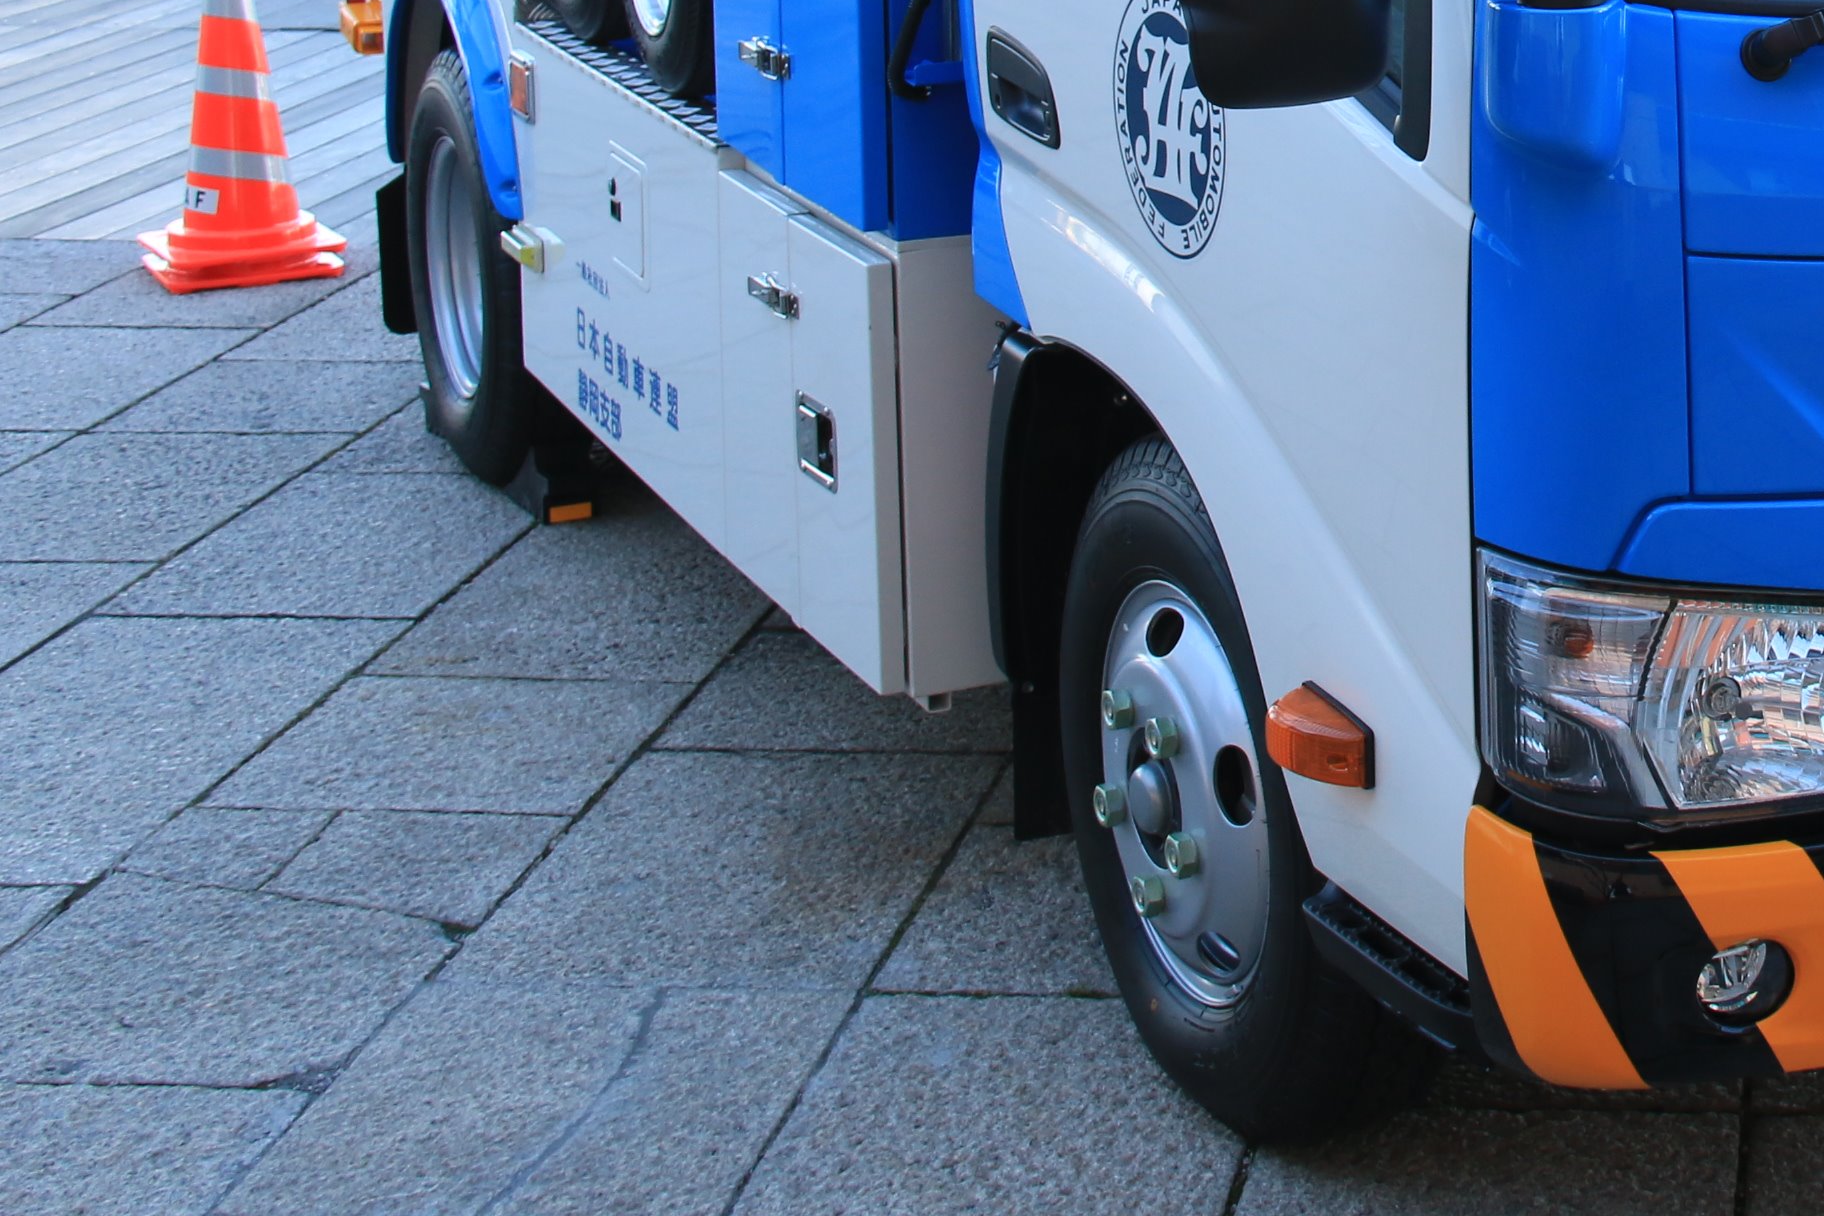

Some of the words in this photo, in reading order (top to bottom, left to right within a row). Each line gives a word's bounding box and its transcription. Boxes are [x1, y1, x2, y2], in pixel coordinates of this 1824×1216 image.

[1116, 40, 1166, 239] FEDERATION
[577, 306, 680, 432] 日本自動車連盟
[578, 367, 623, 442] 静岡支部
